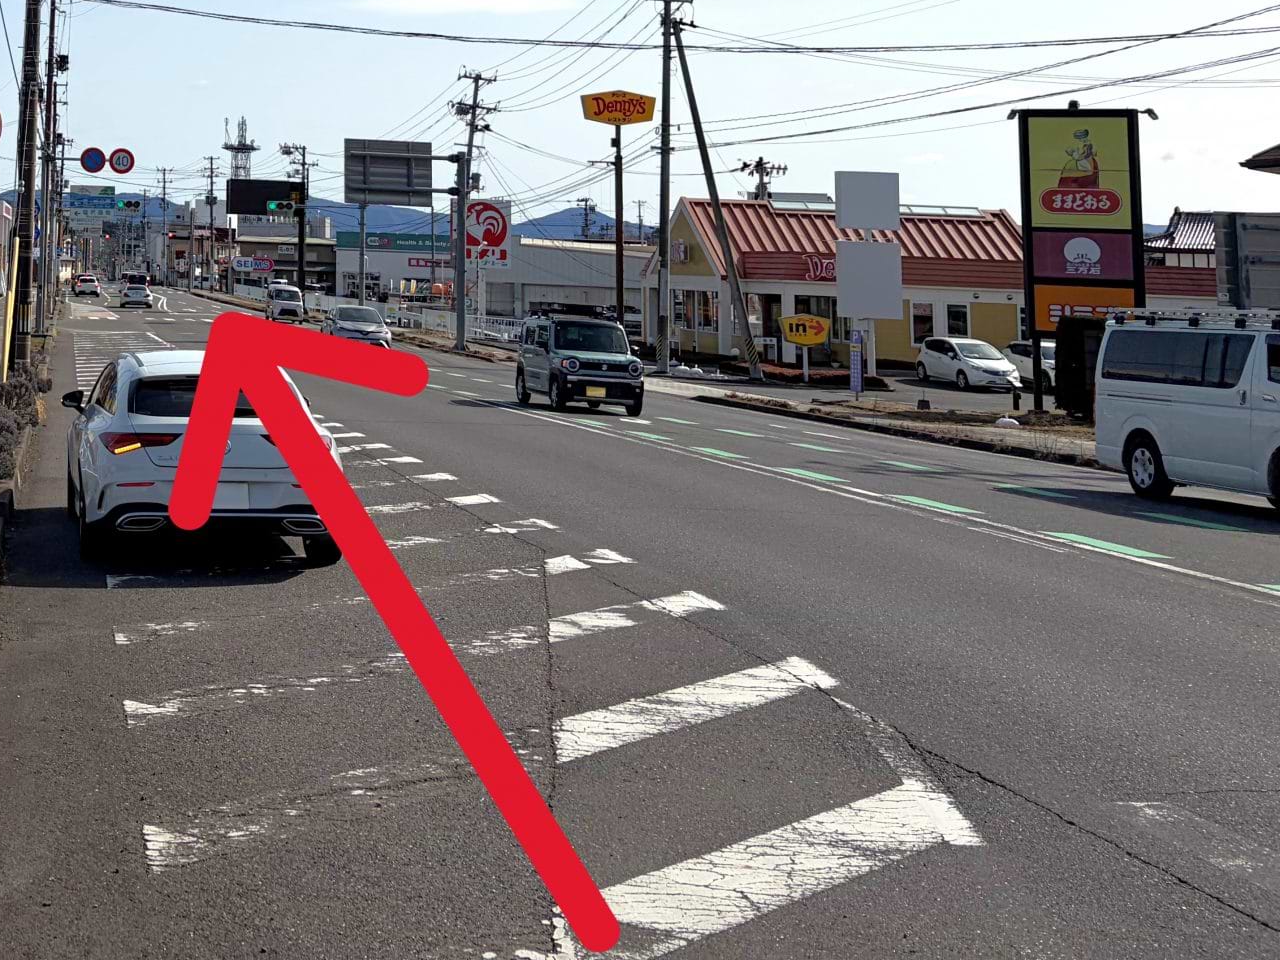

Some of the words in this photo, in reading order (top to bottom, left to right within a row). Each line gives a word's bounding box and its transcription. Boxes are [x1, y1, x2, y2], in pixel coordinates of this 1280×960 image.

[592, 96, 646, 117] Denny's
[115, 155, 129, 167] 40
[1053, 192, 1111, 211] ままどおる
[425, 240, 446, 248] Beuty
[236, 259, 269, 268] SEIMS
[789, 323, 807, 334] in
